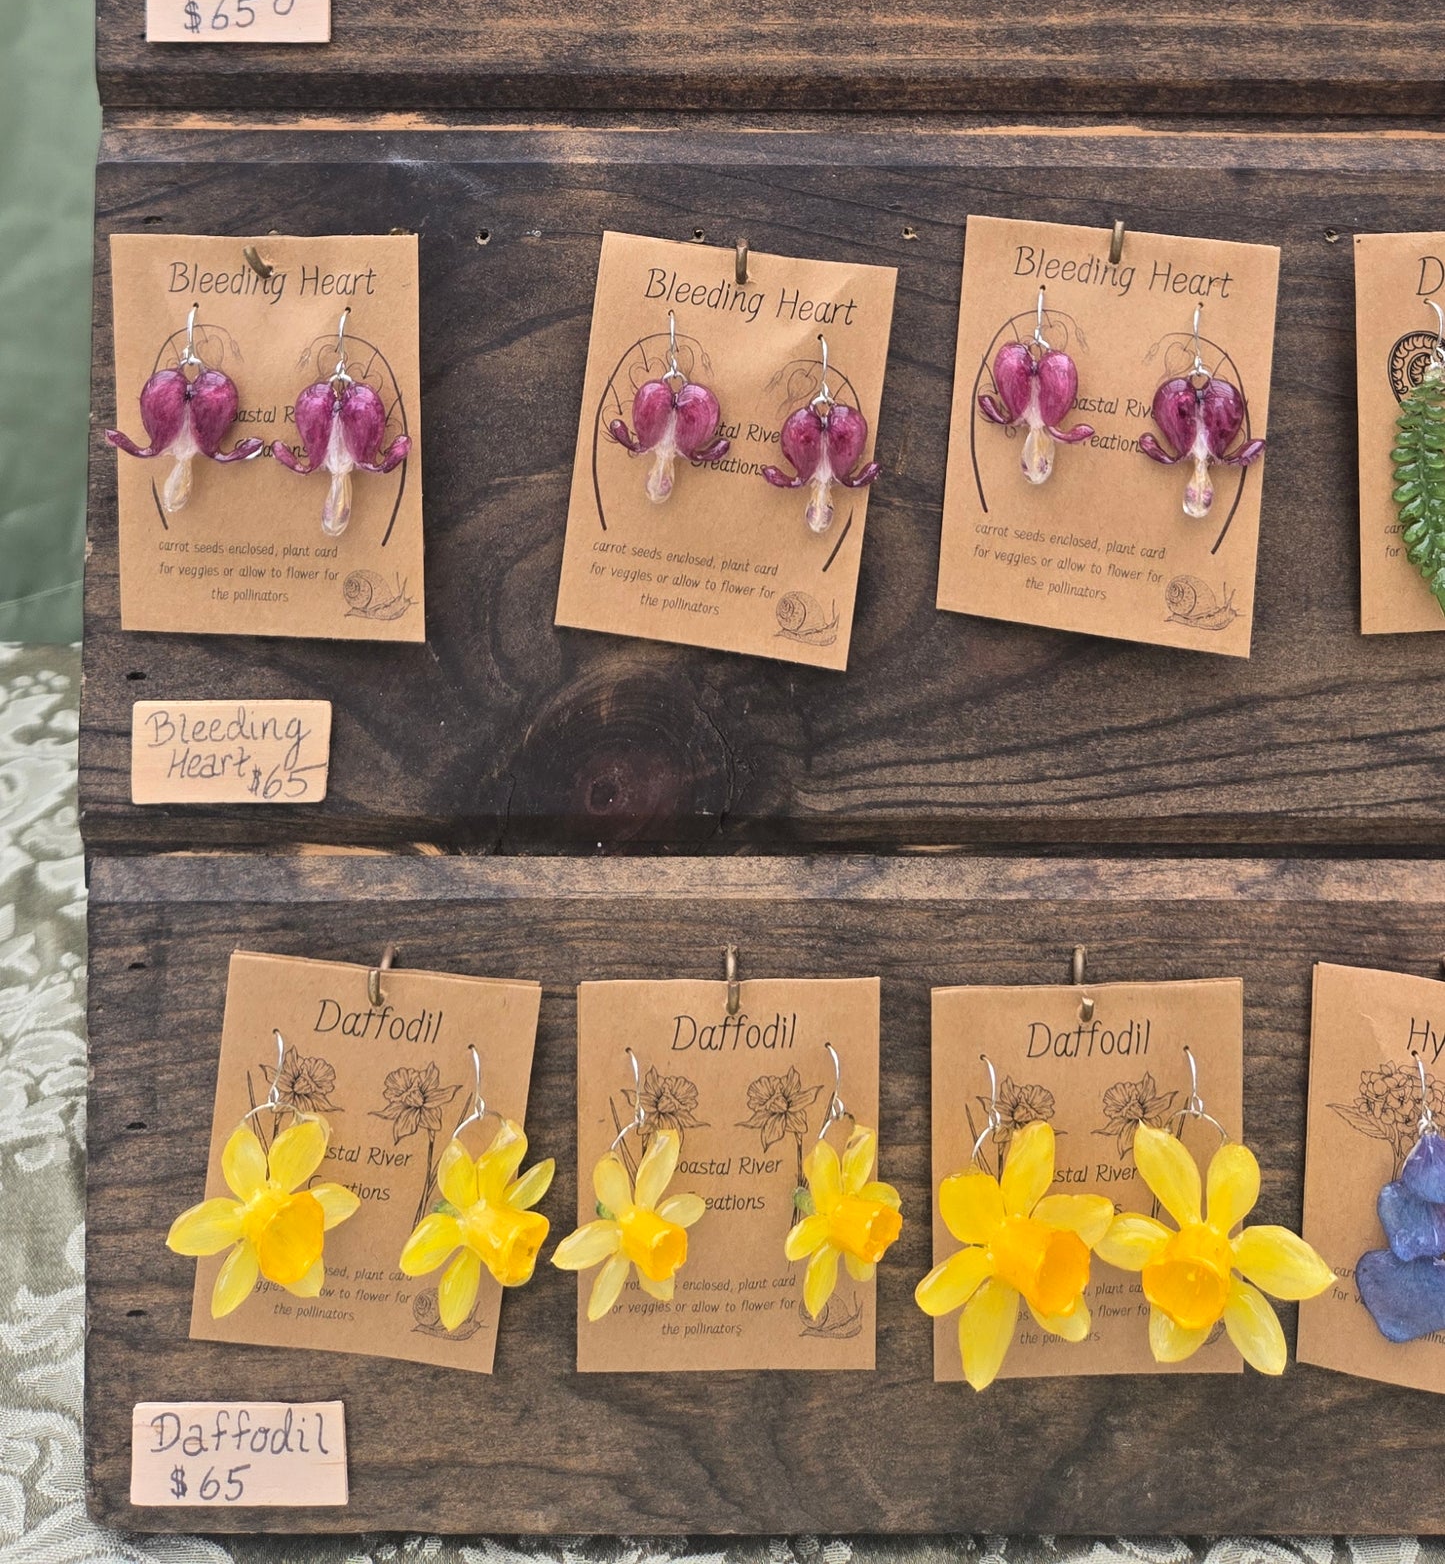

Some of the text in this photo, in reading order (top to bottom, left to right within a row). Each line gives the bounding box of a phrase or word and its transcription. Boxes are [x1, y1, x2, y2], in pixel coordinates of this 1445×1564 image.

[1013, 246, 1234, 298] Bleeding Heart
[169, 262, 376, 304] Bleeding Heart
[644, 268, 857, 326] Bleeding Heart
[159, 540, 338, 558] carrot seeds enclosed, plant card
[975, 523, 1165, 559] carrot seeds enclosed, plant card
[1385, 544, 1400, 557] for
[593, 541, 778, 577] carrot seeds enclosed, plant card
[974, 545, 1164, 583] for veggies or allow to flower for
[160, 563, 339, 581] for veggies or allow to flower for
[591, 563, 775, 599] for veggies or allow to flower for
[211, 588, 288, 603] the pollinators
[1026, 577, 1106, 599] the pollinators
[640, 593, 720, 616] the pollinators
[145, 705, 312, 771] Bleeding
[167, 746, 327, 799] Heart $65
[314, 999, 443, 1044] Daffodil
[672, 1013, 796, 1051] Daffodil
[1027, 1019, 1150, 1058] Daffodil
[367, 1146, 413, 1167] River
[739, 1158, 783, 1174] River
[1096, 1165, 1137, 1182] River
[354, 1268, 385, 1282] plant
[683, 1275, 795, 1292] enclosed, plant card
[339, 1289, 411, 1304] to flower for
[1096, 1282, 1125, 1297] plant
[1332, 1287, 1350, 1303] for
[273, 1303, 354, 1321] the pollinators
[629, 1299, 795, 1316] veggies or allow to flower for
[1098, 1305, 1132, 1318] flower
[662, 1323, 742, 1337] the pollinators
[1020, 1330, 1038, 1345] the
[151, 1408, 328, 1456] Daffodil
